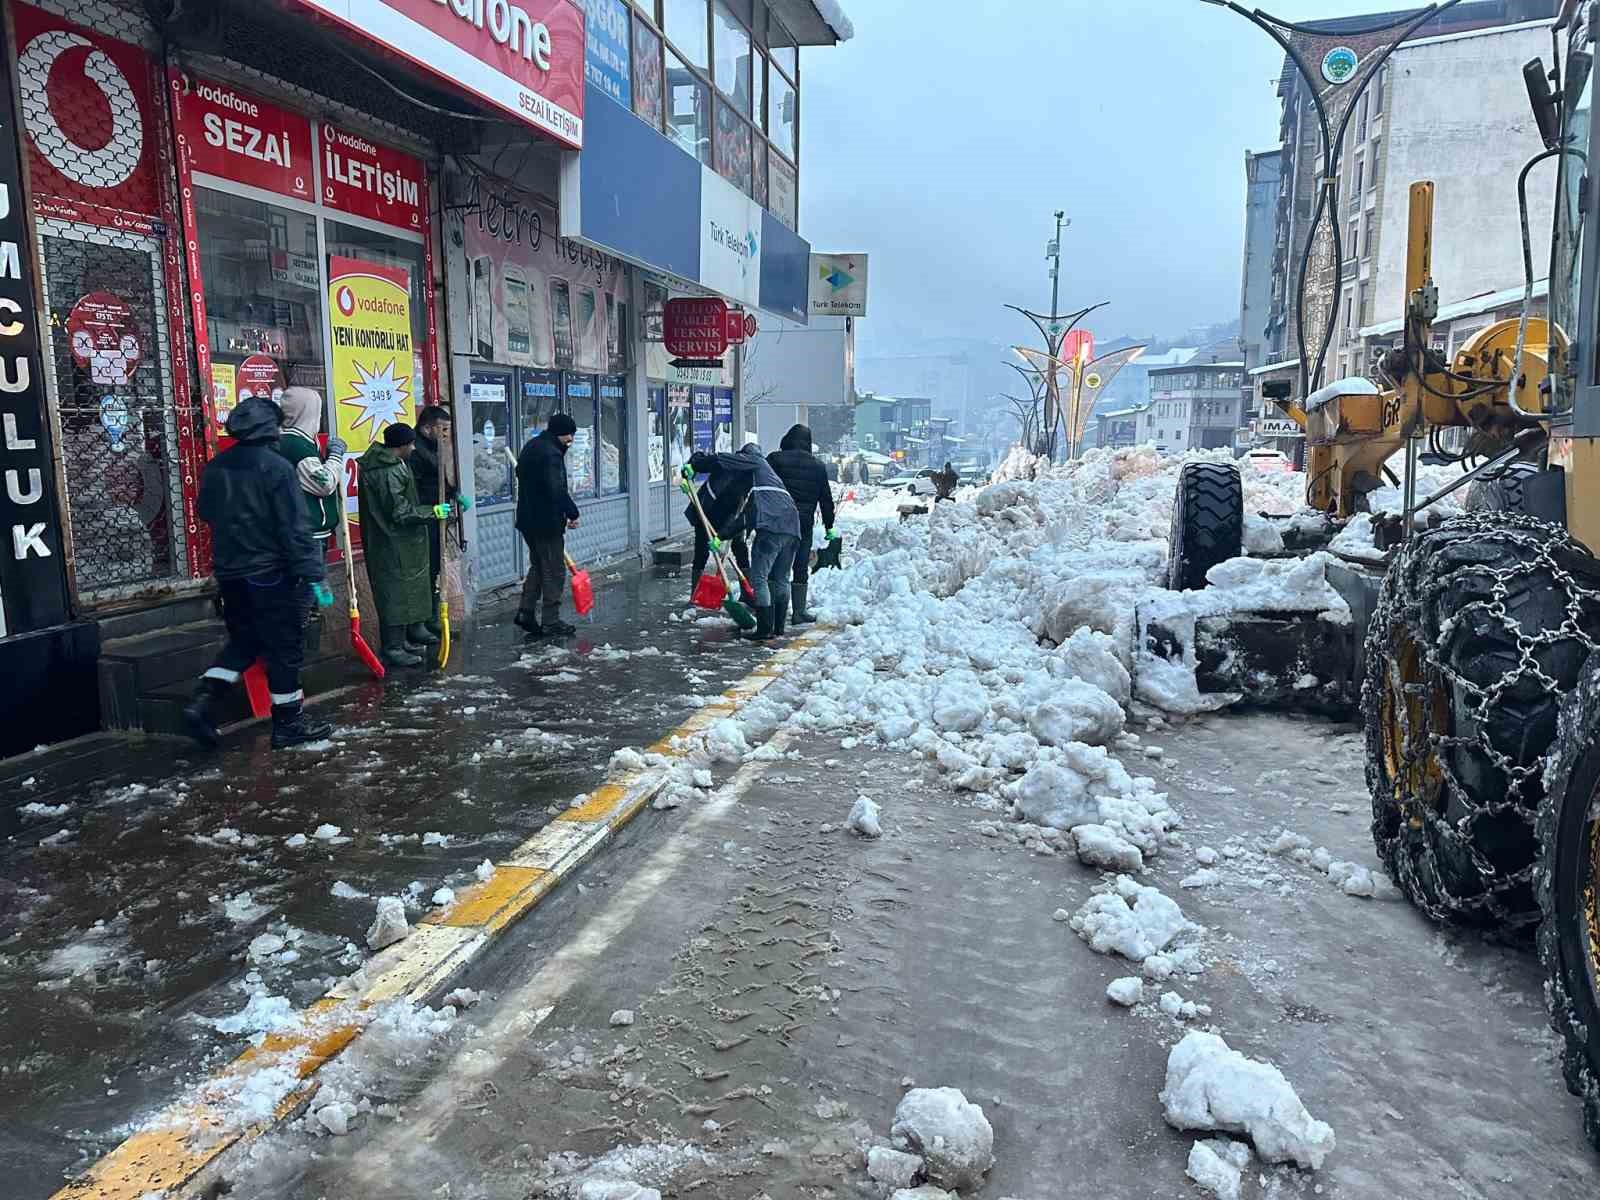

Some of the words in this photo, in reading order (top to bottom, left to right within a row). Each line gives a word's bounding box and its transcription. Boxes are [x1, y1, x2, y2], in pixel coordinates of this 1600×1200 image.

[197, 84, 258, 117] vodafone
[519, 91, 545, 119] SEZAİ
[546, 102, 578, 137] İLETİŞİM
[203, 112, 291, 168] SEZAİ
[337, 132, 377, 156] vodafone
[325, 144, 419, 207] İLETİŞİM
[358, 298, 405, 316] vodafone
[831, 300, 861, 309] Telekom
[333, 324, 353, 347] YENİ
[355, 326, 395, 351] KONTÖRLÜ
[396, 334, 409, 351] HAT
